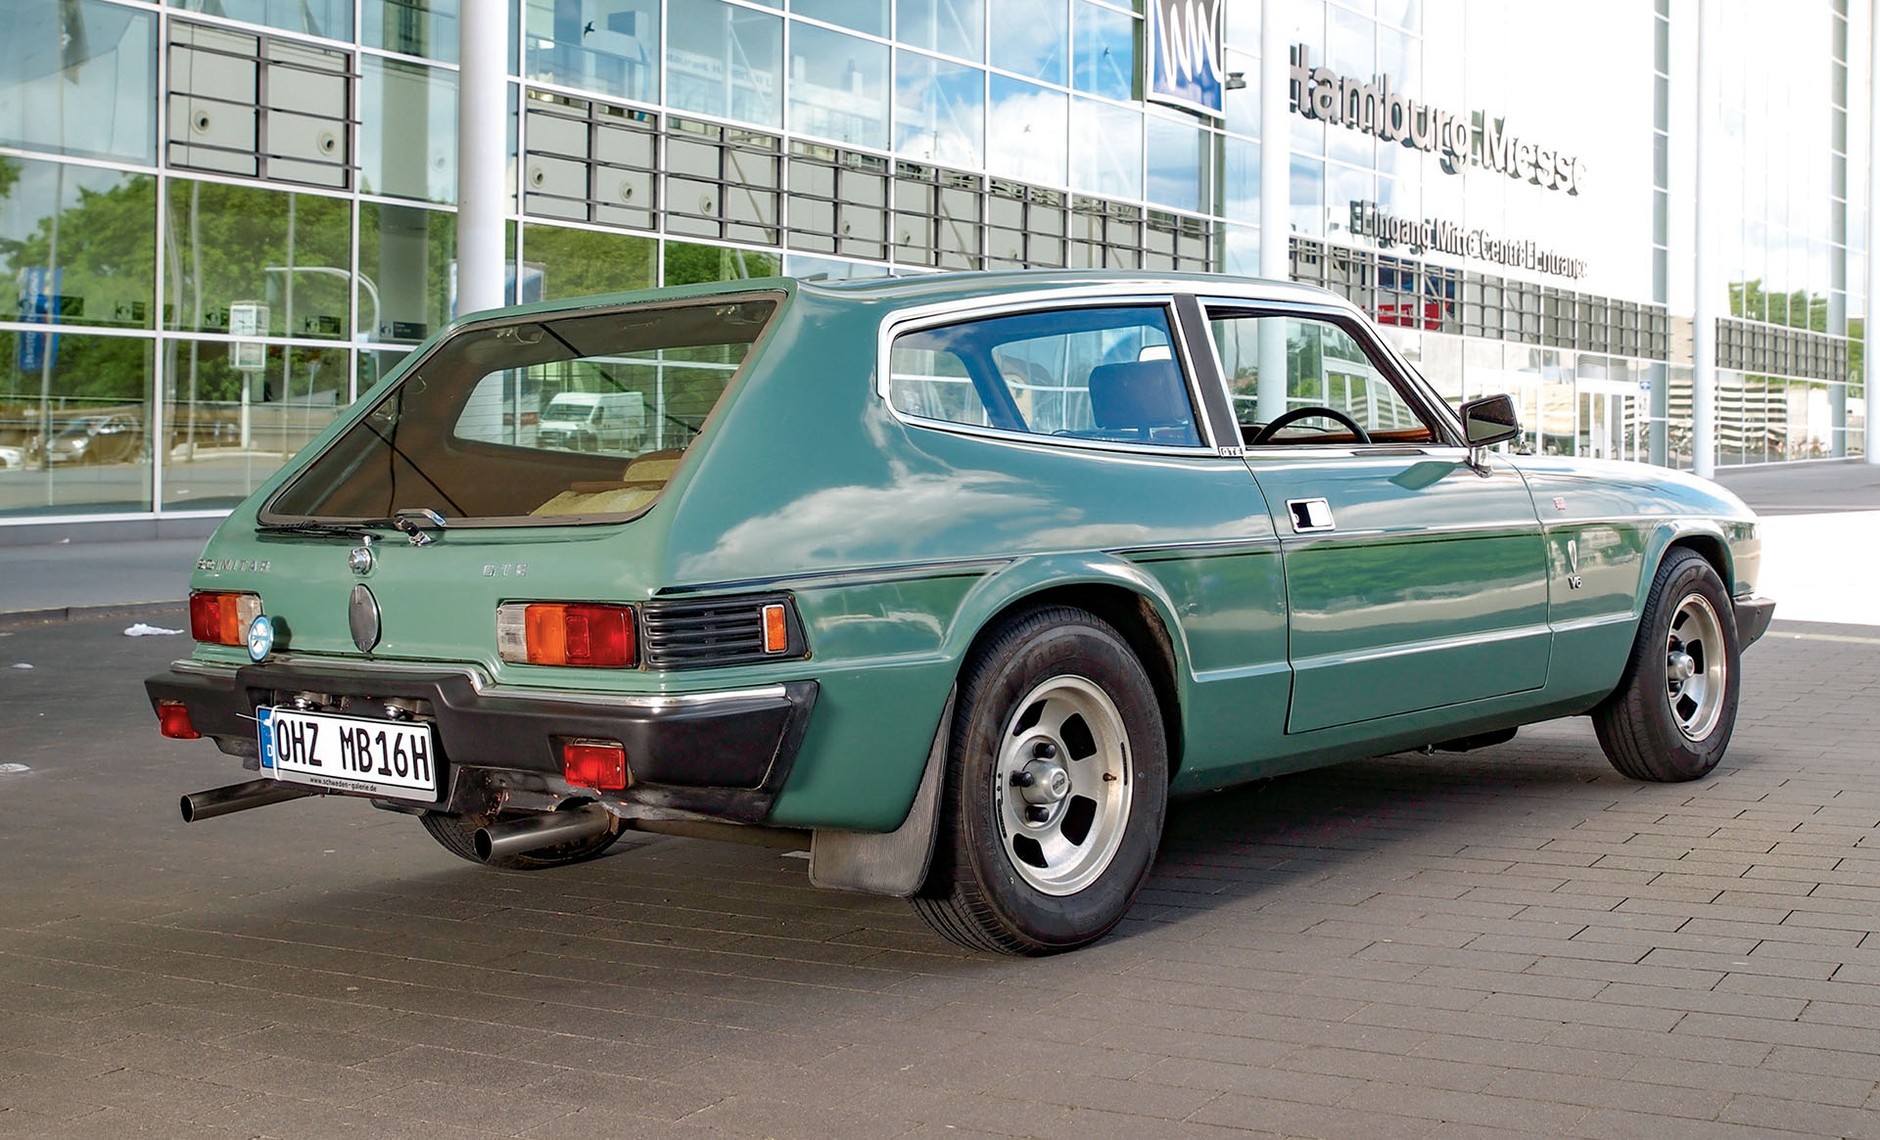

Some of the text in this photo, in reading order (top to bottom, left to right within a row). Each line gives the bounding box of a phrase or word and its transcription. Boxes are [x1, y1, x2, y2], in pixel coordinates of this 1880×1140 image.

[1290, 43, 1468, 174] Hamburg
[1357, 199, 1432, 256] Eingang
[1434, 217, 1480, 258] Mitte
[483, 563, 528, 577] GTE
[1568, 576, 1583, 590] V6
[277, 718, 431, 782] OHZ MB16H
[309, 775, 378, 793] www.schweden-galerie.de
